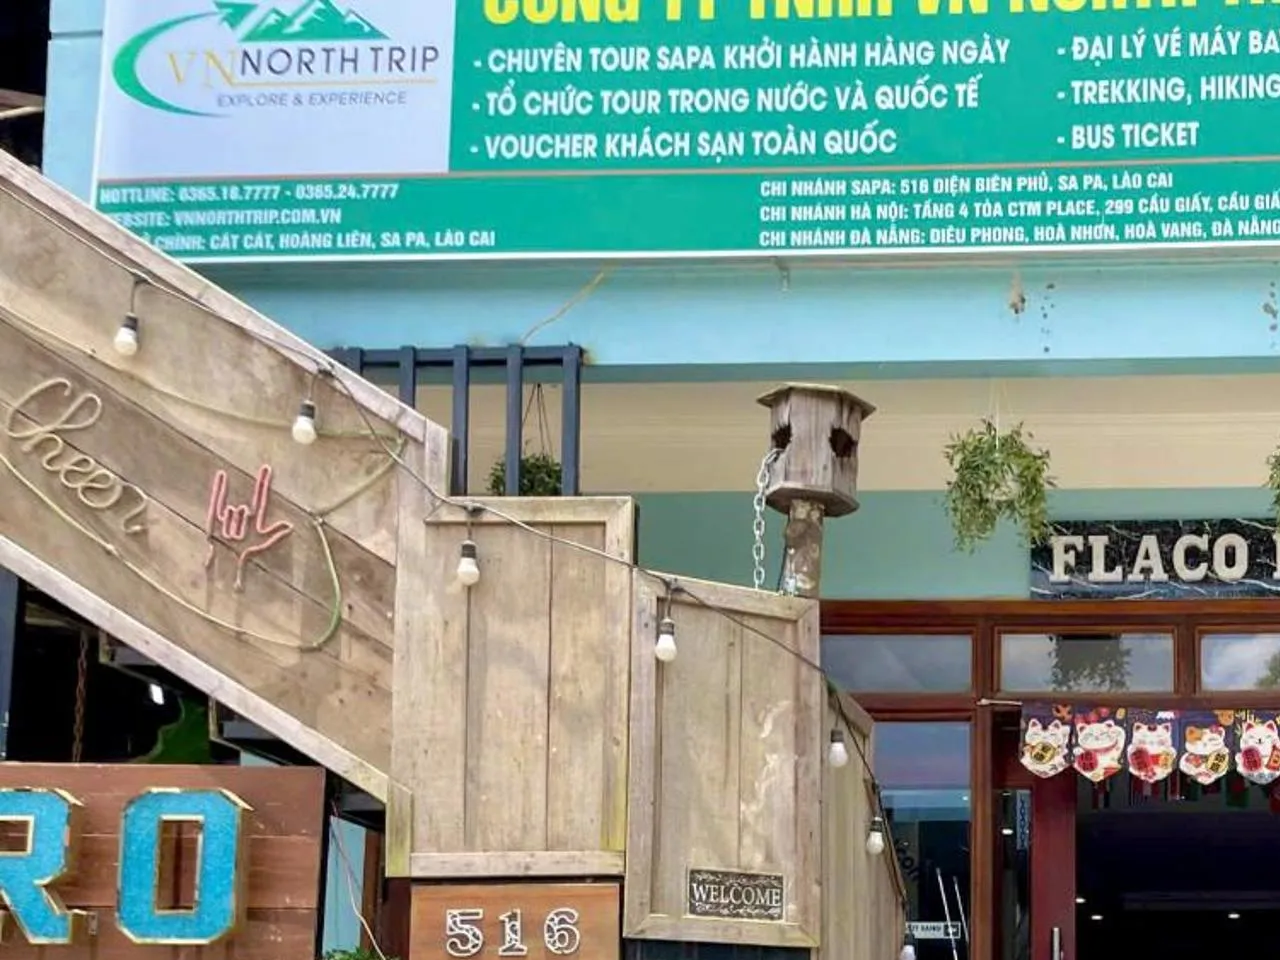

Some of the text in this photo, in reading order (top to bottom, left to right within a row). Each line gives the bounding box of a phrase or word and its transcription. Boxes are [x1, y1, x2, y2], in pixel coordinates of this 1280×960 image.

[370, 45, 440, 73] TRIP
[488, 32, 1010, 73] CHUYÊN TOUR SAPA KHỞI HÀNH HÀNG NGÀY
[1071, 35, 1113, 67] ĐẠI
[1121, 28, 1146, 59] LÝ
[1153, 27, 1181, 57] VÉ
[1189, 25, 1241, 57] MÁY
[217, 90, 407, 108] EXPLORE & EXPERIENCE
[486, 74, 983, 116] TỔ CHỨC TOUR TRONG NƯỚC VÀ QUỐC TẾ
[1071, 77, 1193, 105] TREKKING,
[484, 120, 897, 163] VOUCHER KHÁCH SẠN TOÀN QUỐC
[1072, 121, 1200, 149] BUS TICKET
[760, 180, 786, 197] CHI
[791, 177, 846, 197] NHÁNH
[851, 179, 896, 195] SAPA:
[975, 174, 1012, 193] BIÊN
[1058, 175, 1078, 191] SA
[1083, 174, 1108, 192] PA,
[1112, 170, 1142, 189] LÀO
[1147, 172, 1173, 189] CAI
[108, 211, 171, 228] EBSITE:
[760, 205, 786, 222] CHI
[791, 202, 846, 221] NHÁNH
[851, 202, 871, 220] HÀ
[959, 202, 968, 218] 4
[1008, 201, 1041, 217] CTM
[1046, 199, 1100, 217] PLACE,
[380, 231, 400, 247] SA
[435, 228, 464, 246] LÀO
[469, 230, 496, 246] CAI
[759, 230, 785, 246] CHI
[790, 227, 845, 246] NHÁNH
[850, 226, 871, 245] ĐÀ
[1211, 218, 1233, 236] ĐÀ
[1048, 533, 1249, 582] FLACO
[692, 883, 781, 906] WELCOME
[446, 907, 580, 957] 516
